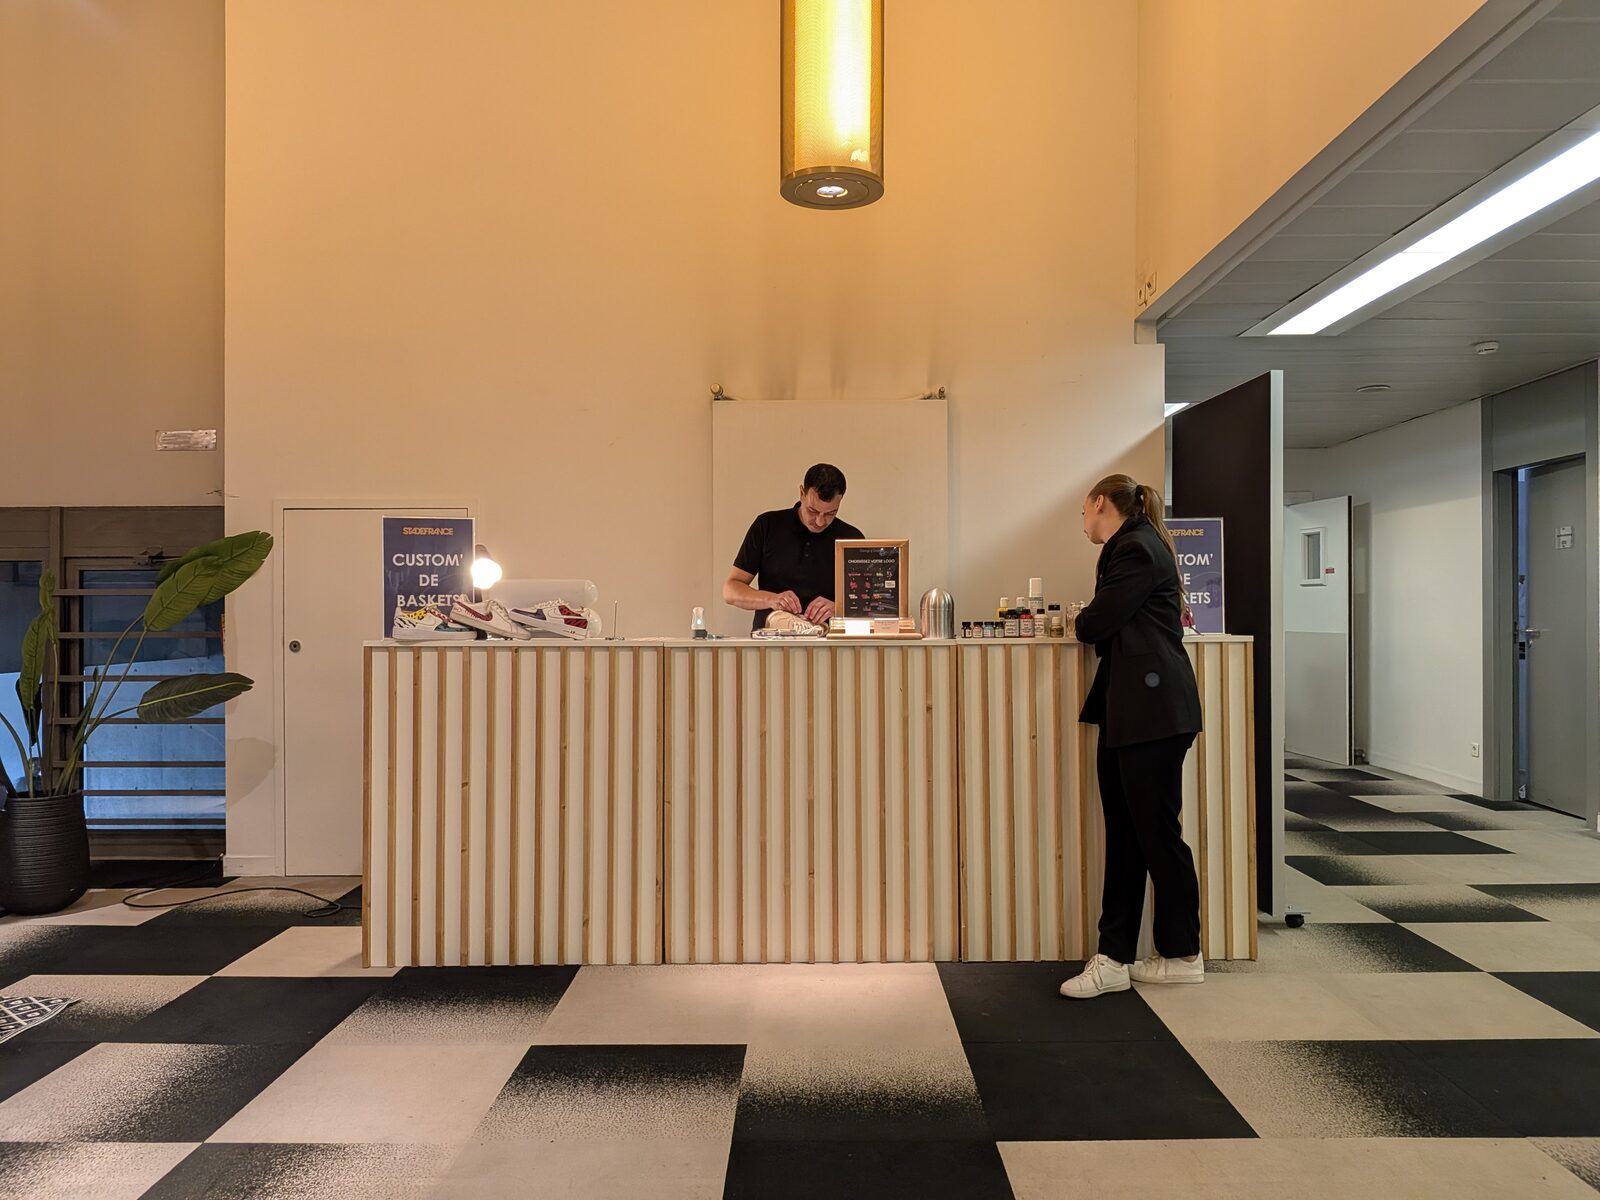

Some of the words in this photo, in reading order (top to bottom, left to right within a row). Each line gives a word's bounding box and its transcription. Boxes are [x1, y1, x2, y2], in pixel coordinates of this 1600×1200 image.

[392, 553, 463, 567] CUSTOM'
[1177, 553, 1214, 566] TOM'
[419, 574, 439, 587] DE
